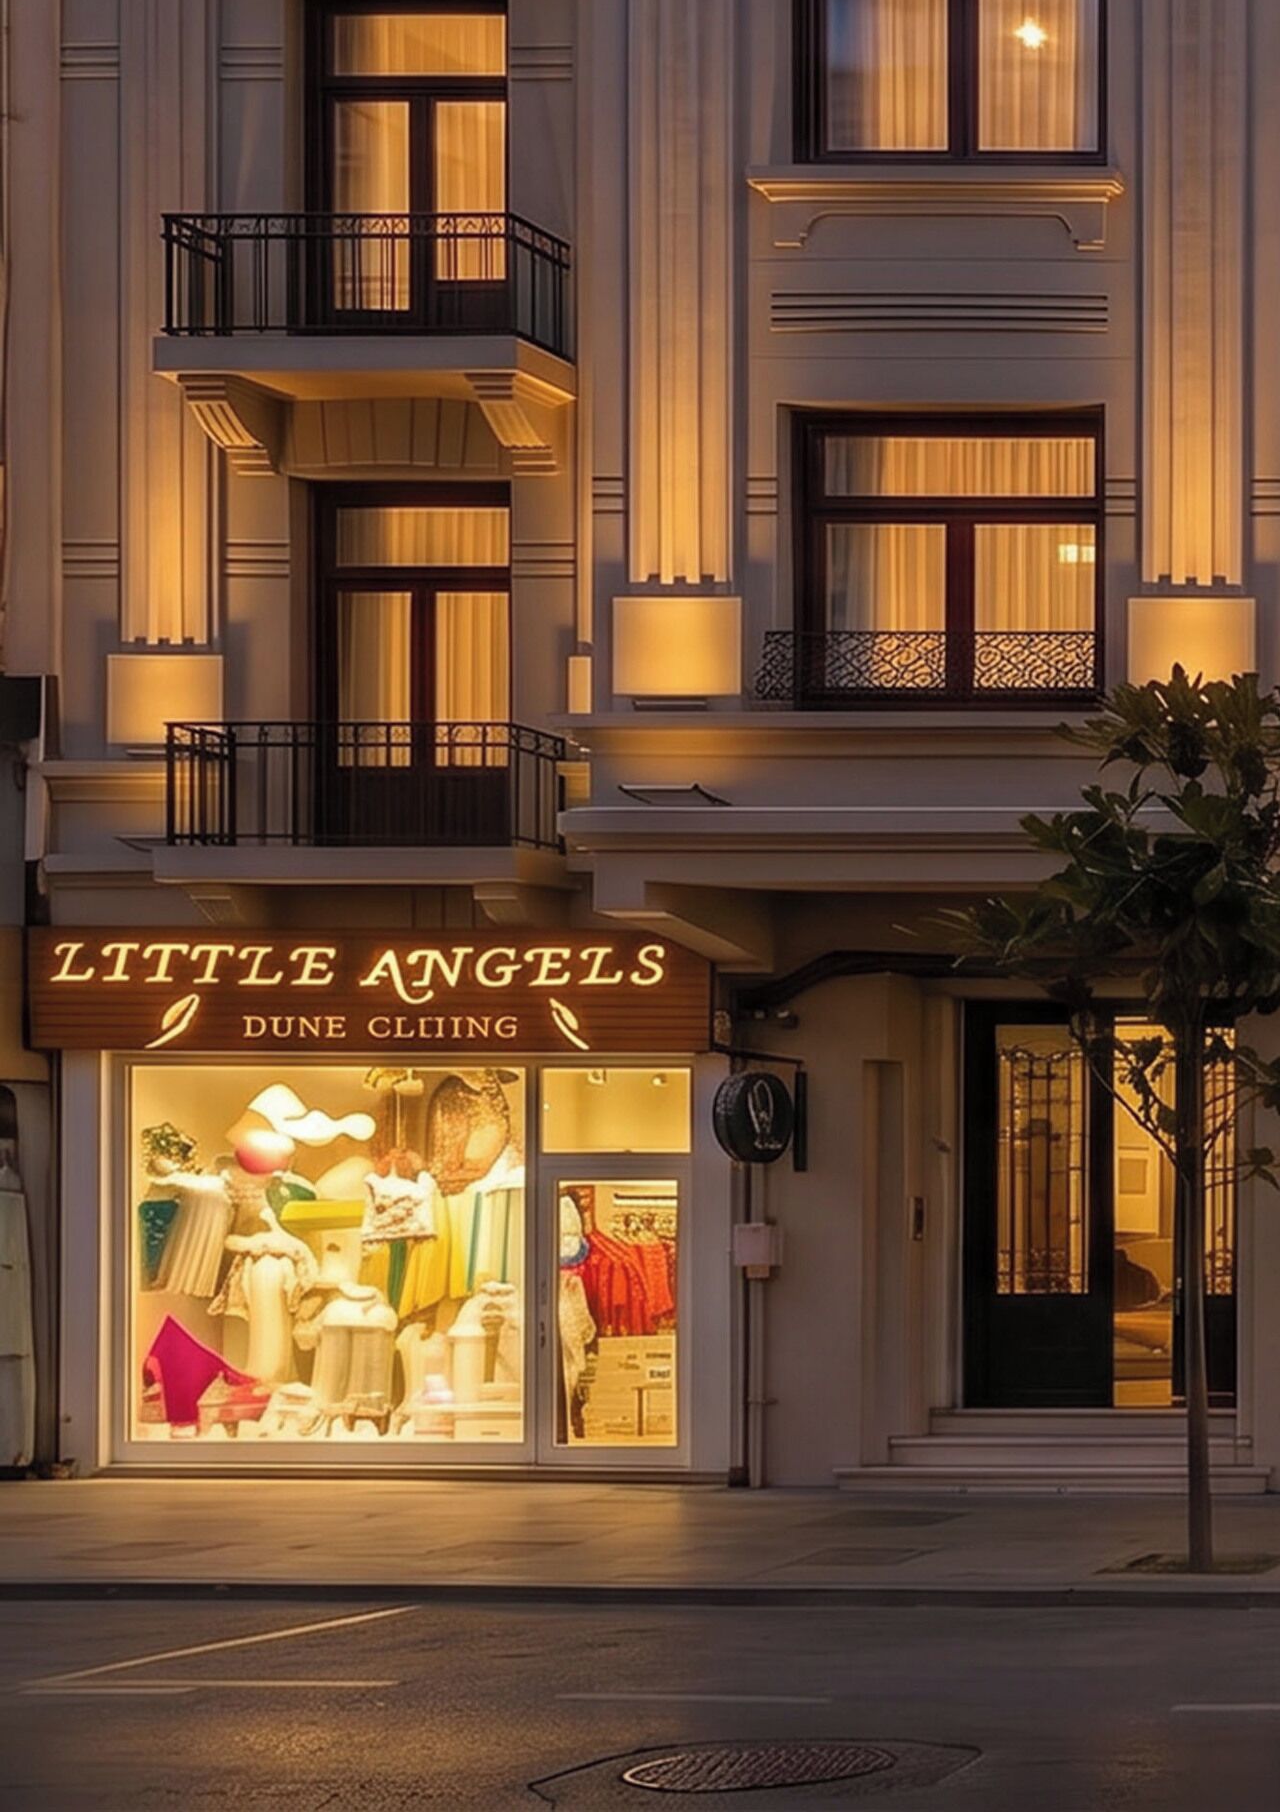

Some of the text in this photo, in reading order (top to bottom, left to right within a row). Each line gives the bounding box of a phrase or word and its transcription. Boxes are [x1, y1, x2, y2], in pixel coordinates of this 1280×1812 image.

[51, 942, 666, 1005] LITTLE ANGELS
[242, 1015, 347, 1039] DUNE
